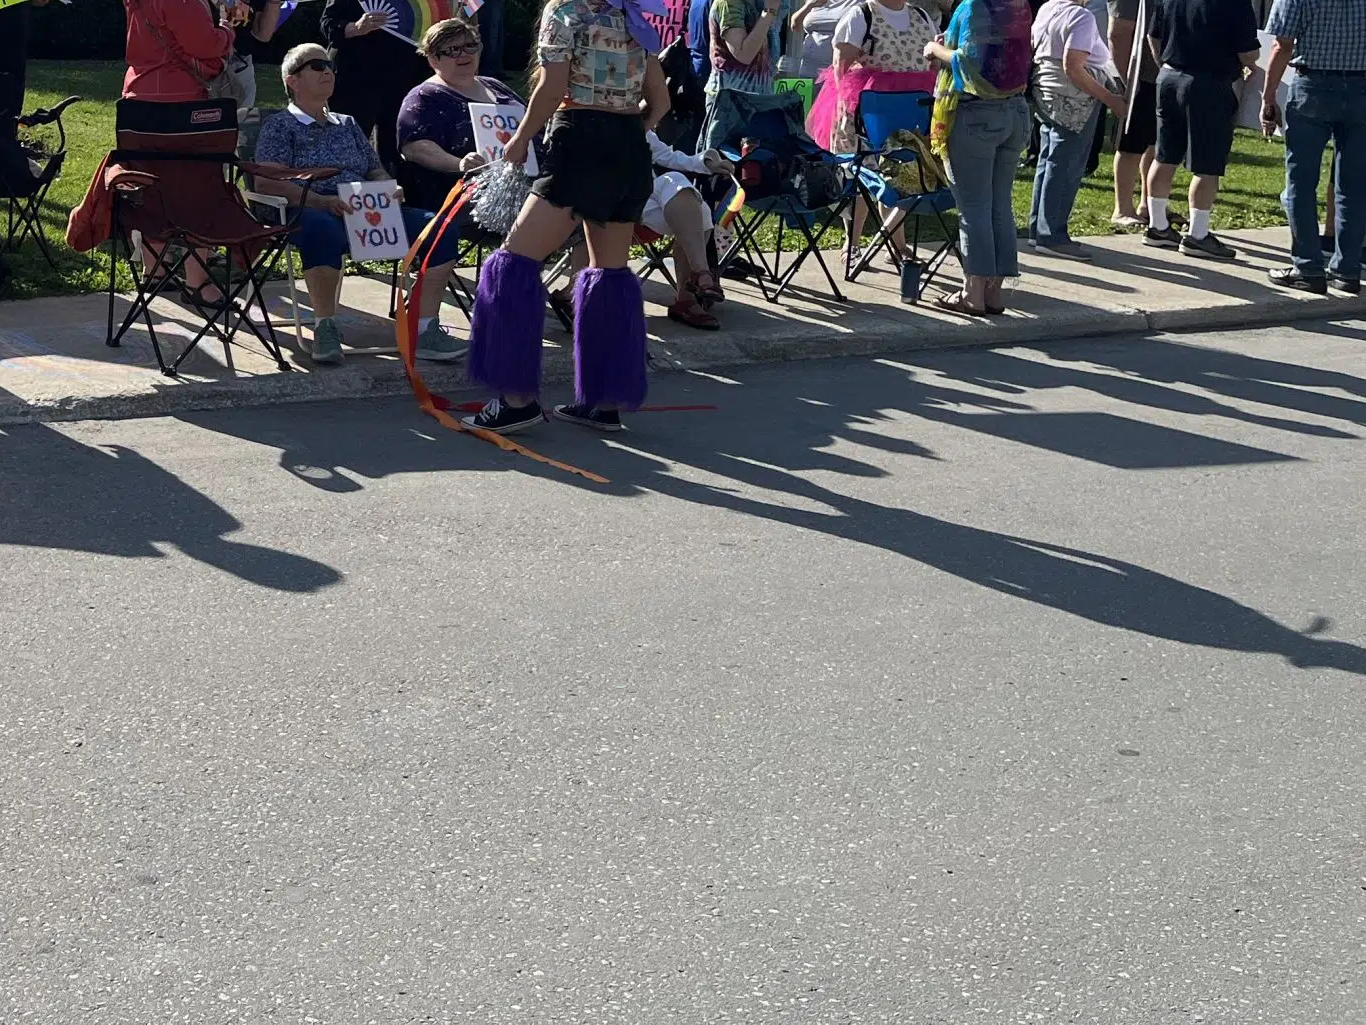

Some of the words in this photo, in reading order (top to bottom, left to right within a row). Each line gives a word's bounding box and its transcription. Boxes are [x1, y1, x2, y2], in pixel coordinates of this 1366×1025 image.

[480, 114, 520, 130] GOD
[349, 193, 391, 210] GOD
[355, 227, 399, 247] YOU
